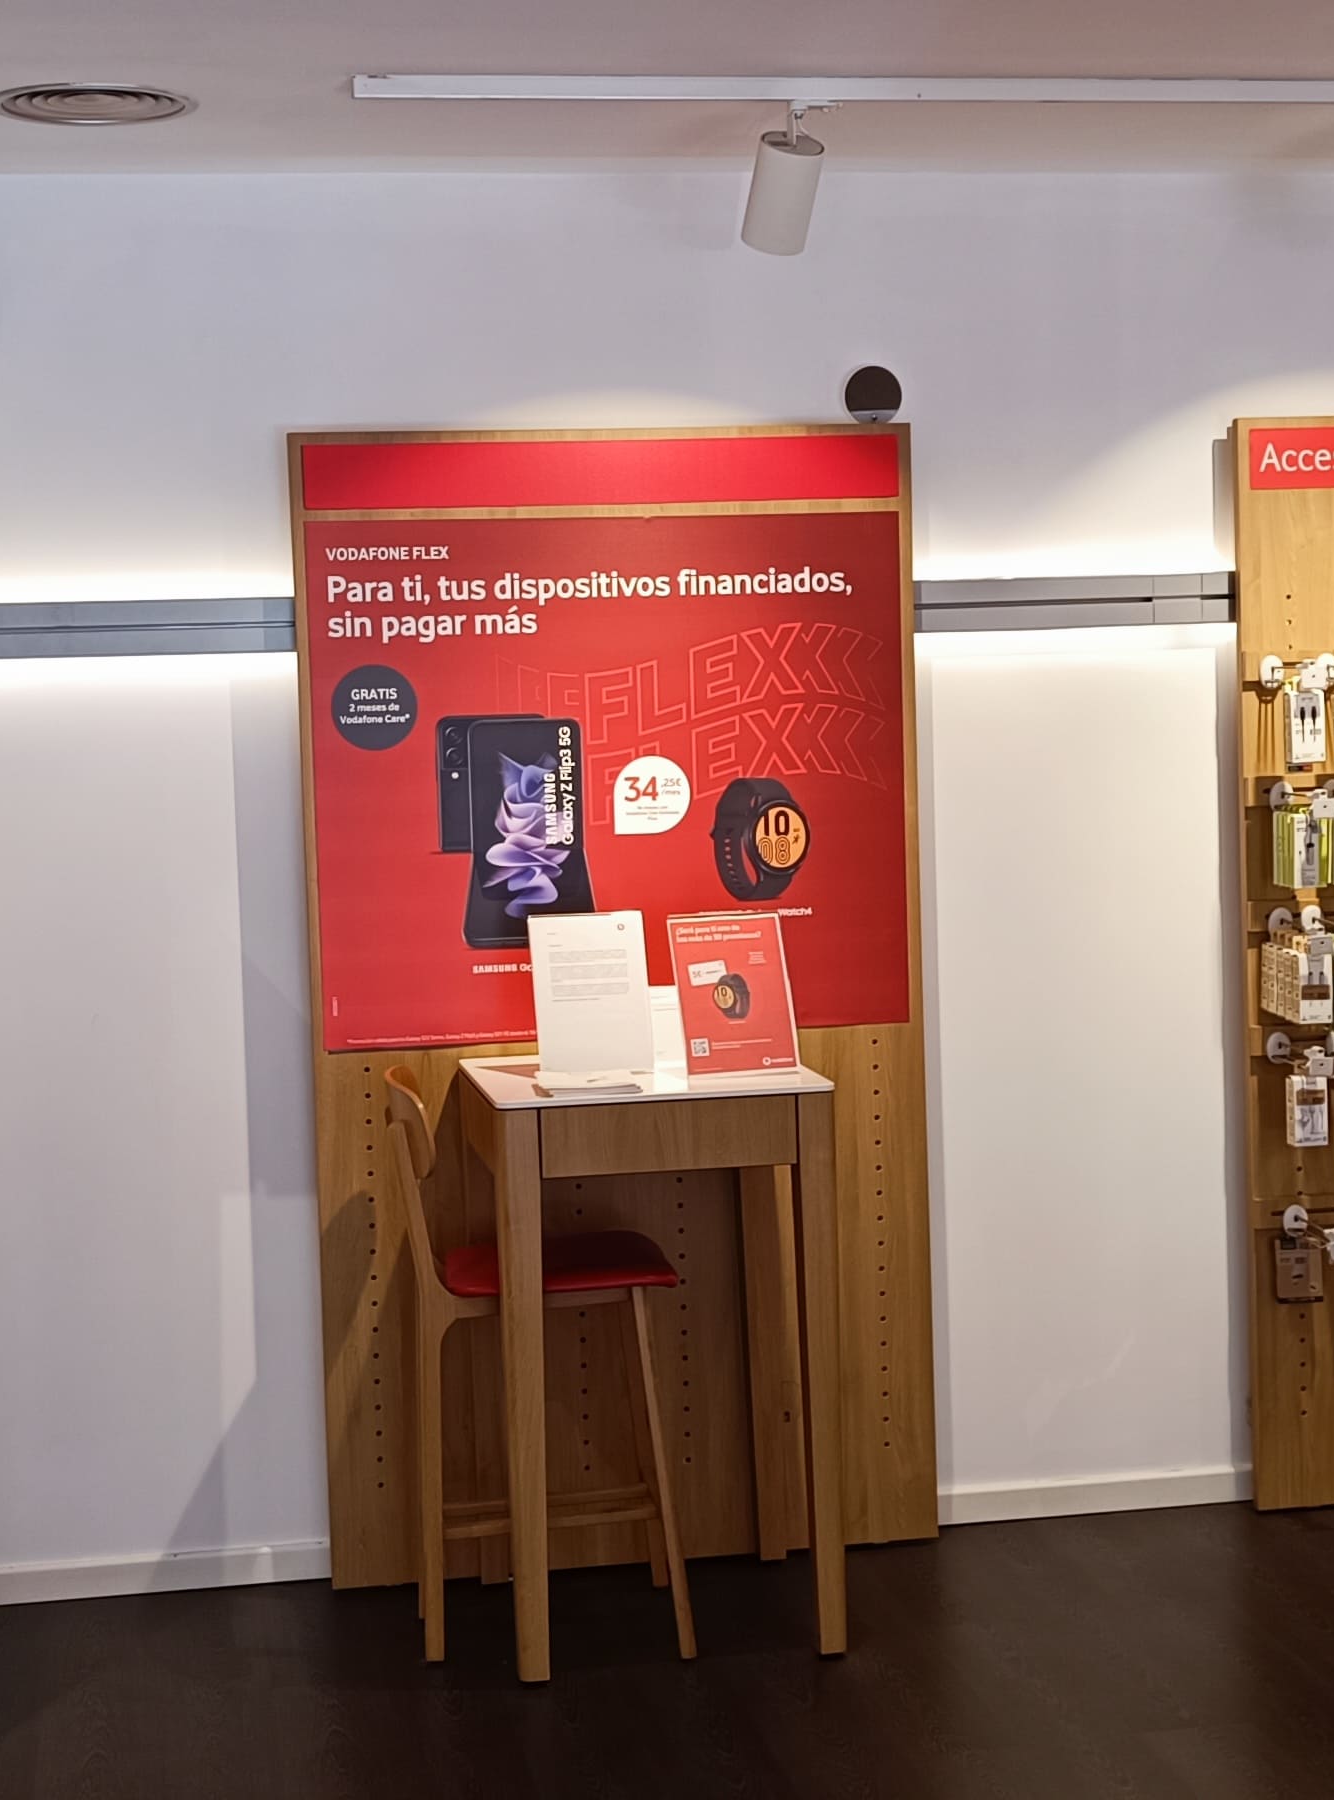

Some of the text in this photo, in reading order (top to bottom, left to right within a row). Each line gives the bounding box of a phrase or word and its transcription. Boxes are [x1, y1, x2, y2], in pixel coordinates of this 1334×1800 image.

[325, 546, 450, 561] VODAFONE FLEX
[327, 566, 853, 606] Para ti, tus dispositivos financiados,
[328, 605, 537, 644] sin pagar más
[351, 687, 398, 701] GRATIS
[339, 715, 383, 724] Vodafone
[349, 702, 400, 713] 2 meses de
[558, 726, 576, 845] Galaxy Z Flip3 5G
[624, 775, 659, 802] 34
[544, 773, 557, 845] SAMSUNG
[764, 810, 790, 836] 10
[472, 964, 518, 974] SAMSUNG
